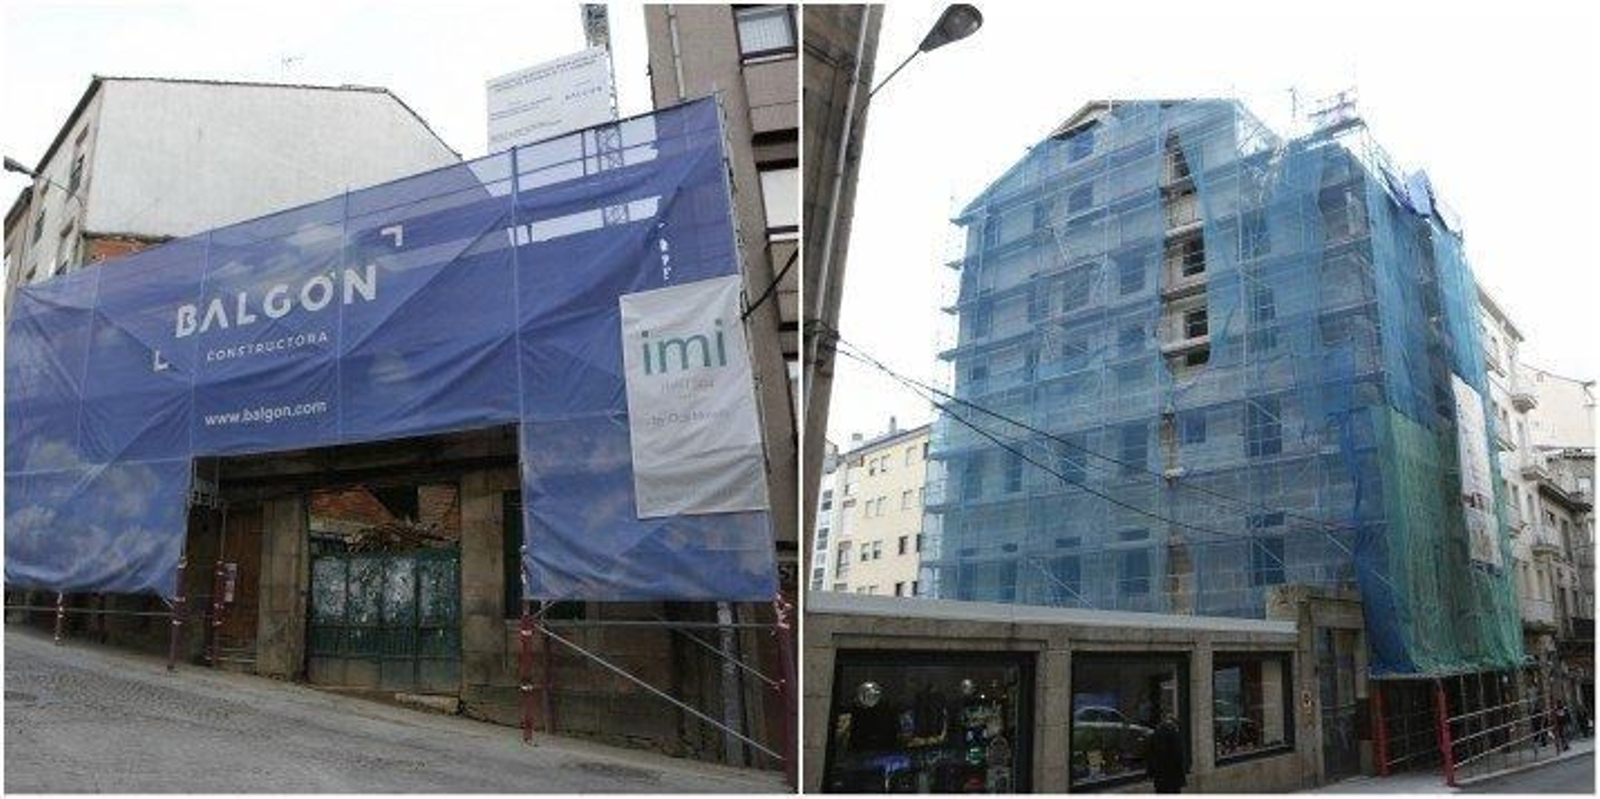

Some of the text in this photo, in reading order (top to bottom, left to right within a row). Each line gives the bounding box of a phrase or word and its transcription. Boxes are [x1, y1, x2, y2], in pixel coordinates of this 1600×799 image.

[175, 264, 376, 338] BALGÓN
[206, 331, 329, 361] CONSTRUCTORA
[641, 319, 727, 375] imi
[205, 400, 327, 425] www.balgon.com
